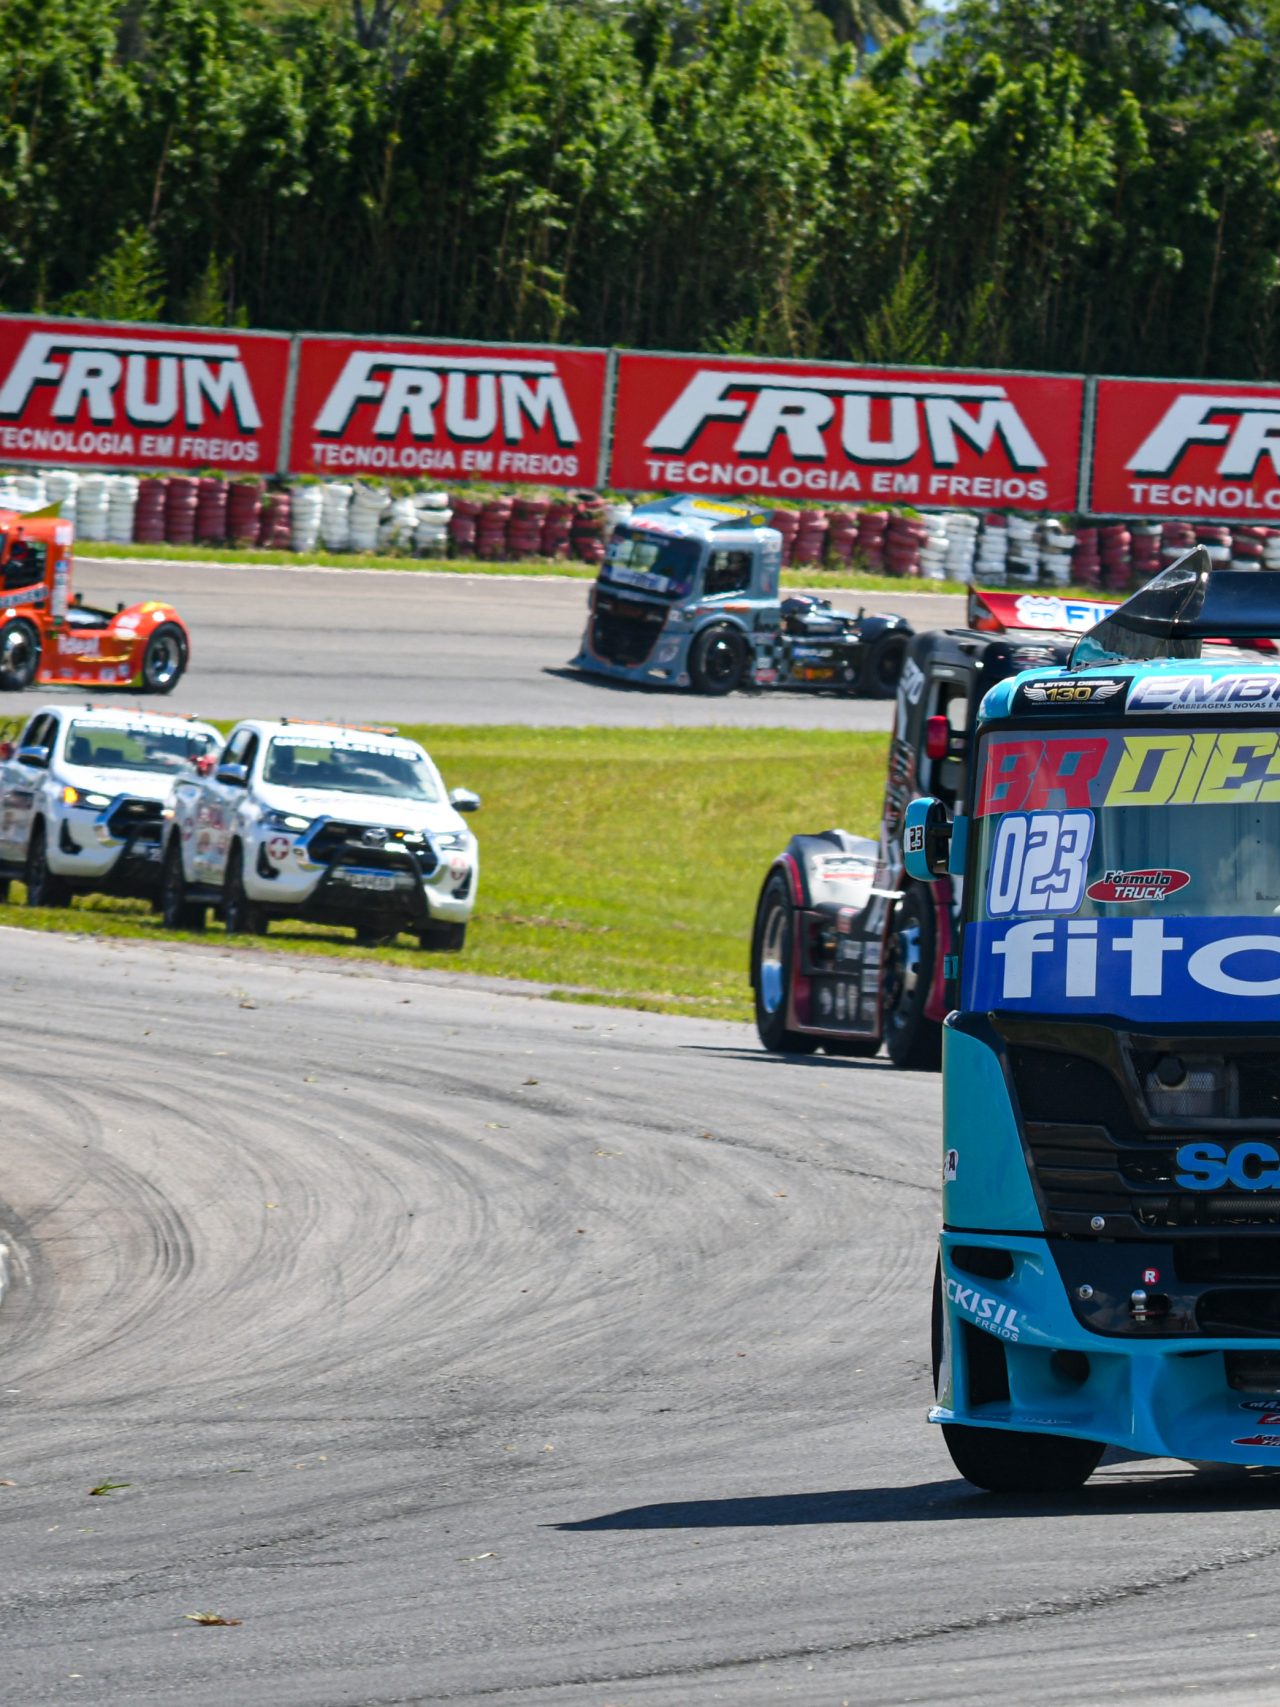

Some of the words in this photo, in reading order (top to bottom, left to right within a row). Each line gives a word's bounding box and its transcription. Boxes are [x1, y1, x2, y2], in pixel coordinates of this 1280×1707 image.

[0, 331, 262, 430] FRUM
[314, 351, 581, 444] FRUM
[644, 370, 1047, 469] FRUM
[140, 435, 174, 457] EM
[179, 438, 258, 462] FREIOS
[312, 443, 456, 474] TECNOLOGIA
[461, 453, 494, 473] EM
[500, 453, 579, 477] FREIOS
[645, 459, 860, 492] TECNOLOGIA
[871, 471, 918, 495] EM
[928, 473, 1048, 501] FREIOS
[1047, 687, 1092, 701] 130
[975, 737, 1109, 819] BR
[986, 809, 1095, 918] 023
[1103, 870, 1172, 887] Fórmula
[1113, 885, 1168, 900] TRUCK
[1144, 1270, 1157, 1283] R
[944, 1276, 1020, 1333] CKISIL
[975, 1316, 1019, 1342] FREIOS
